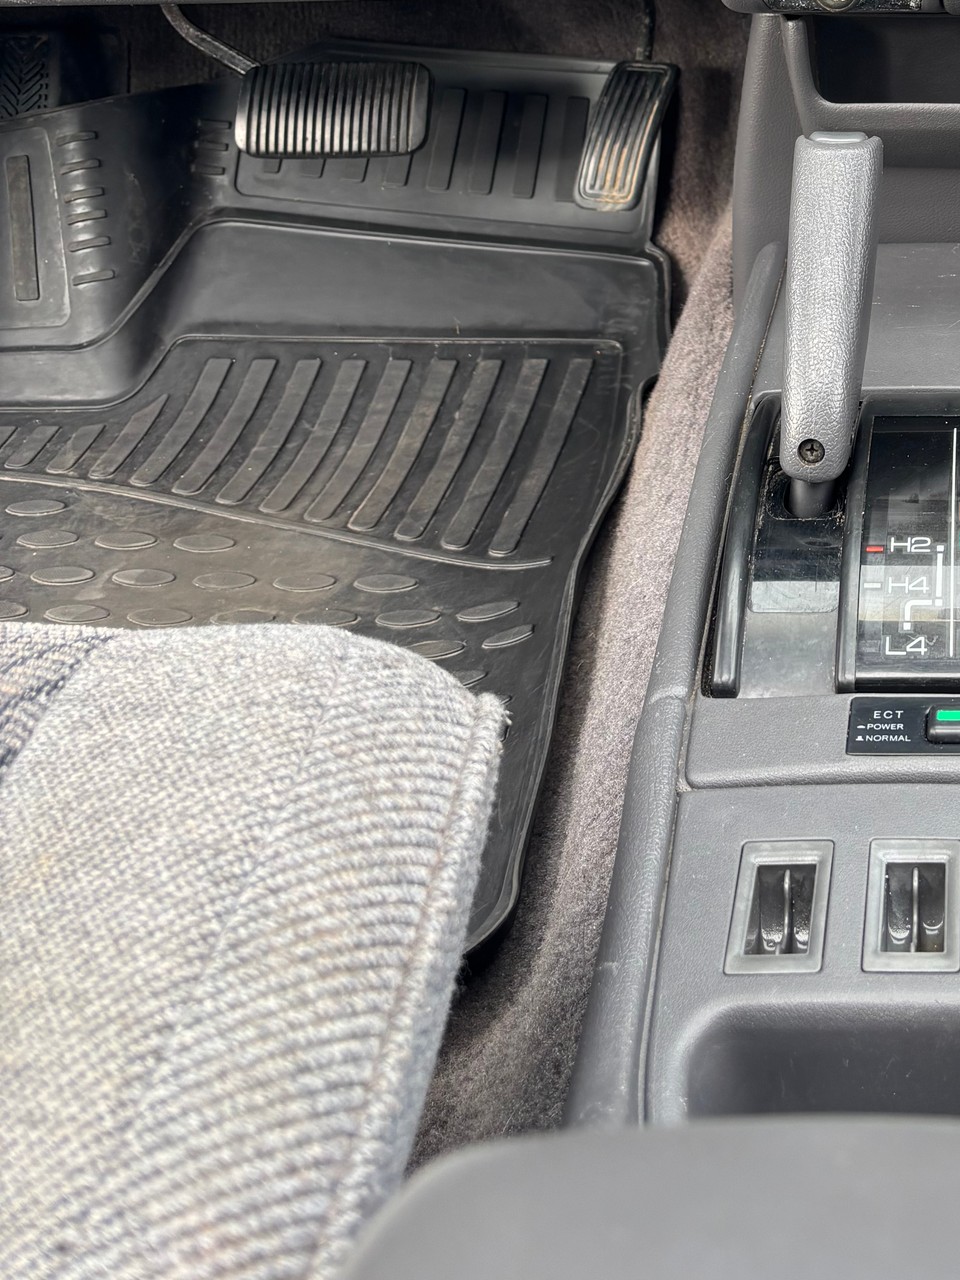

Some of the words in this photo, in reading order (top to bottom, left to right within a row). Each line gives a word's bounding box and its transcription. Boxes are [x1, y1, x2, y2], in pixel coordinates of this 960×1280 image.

[890, 537, 931, 552] H2
[888, 576, 929, 594] H4
[886, 636, 928, 655] L4
[873, 710, 904, 719] ECT
[865, 734, 911, 742] NORMAL
